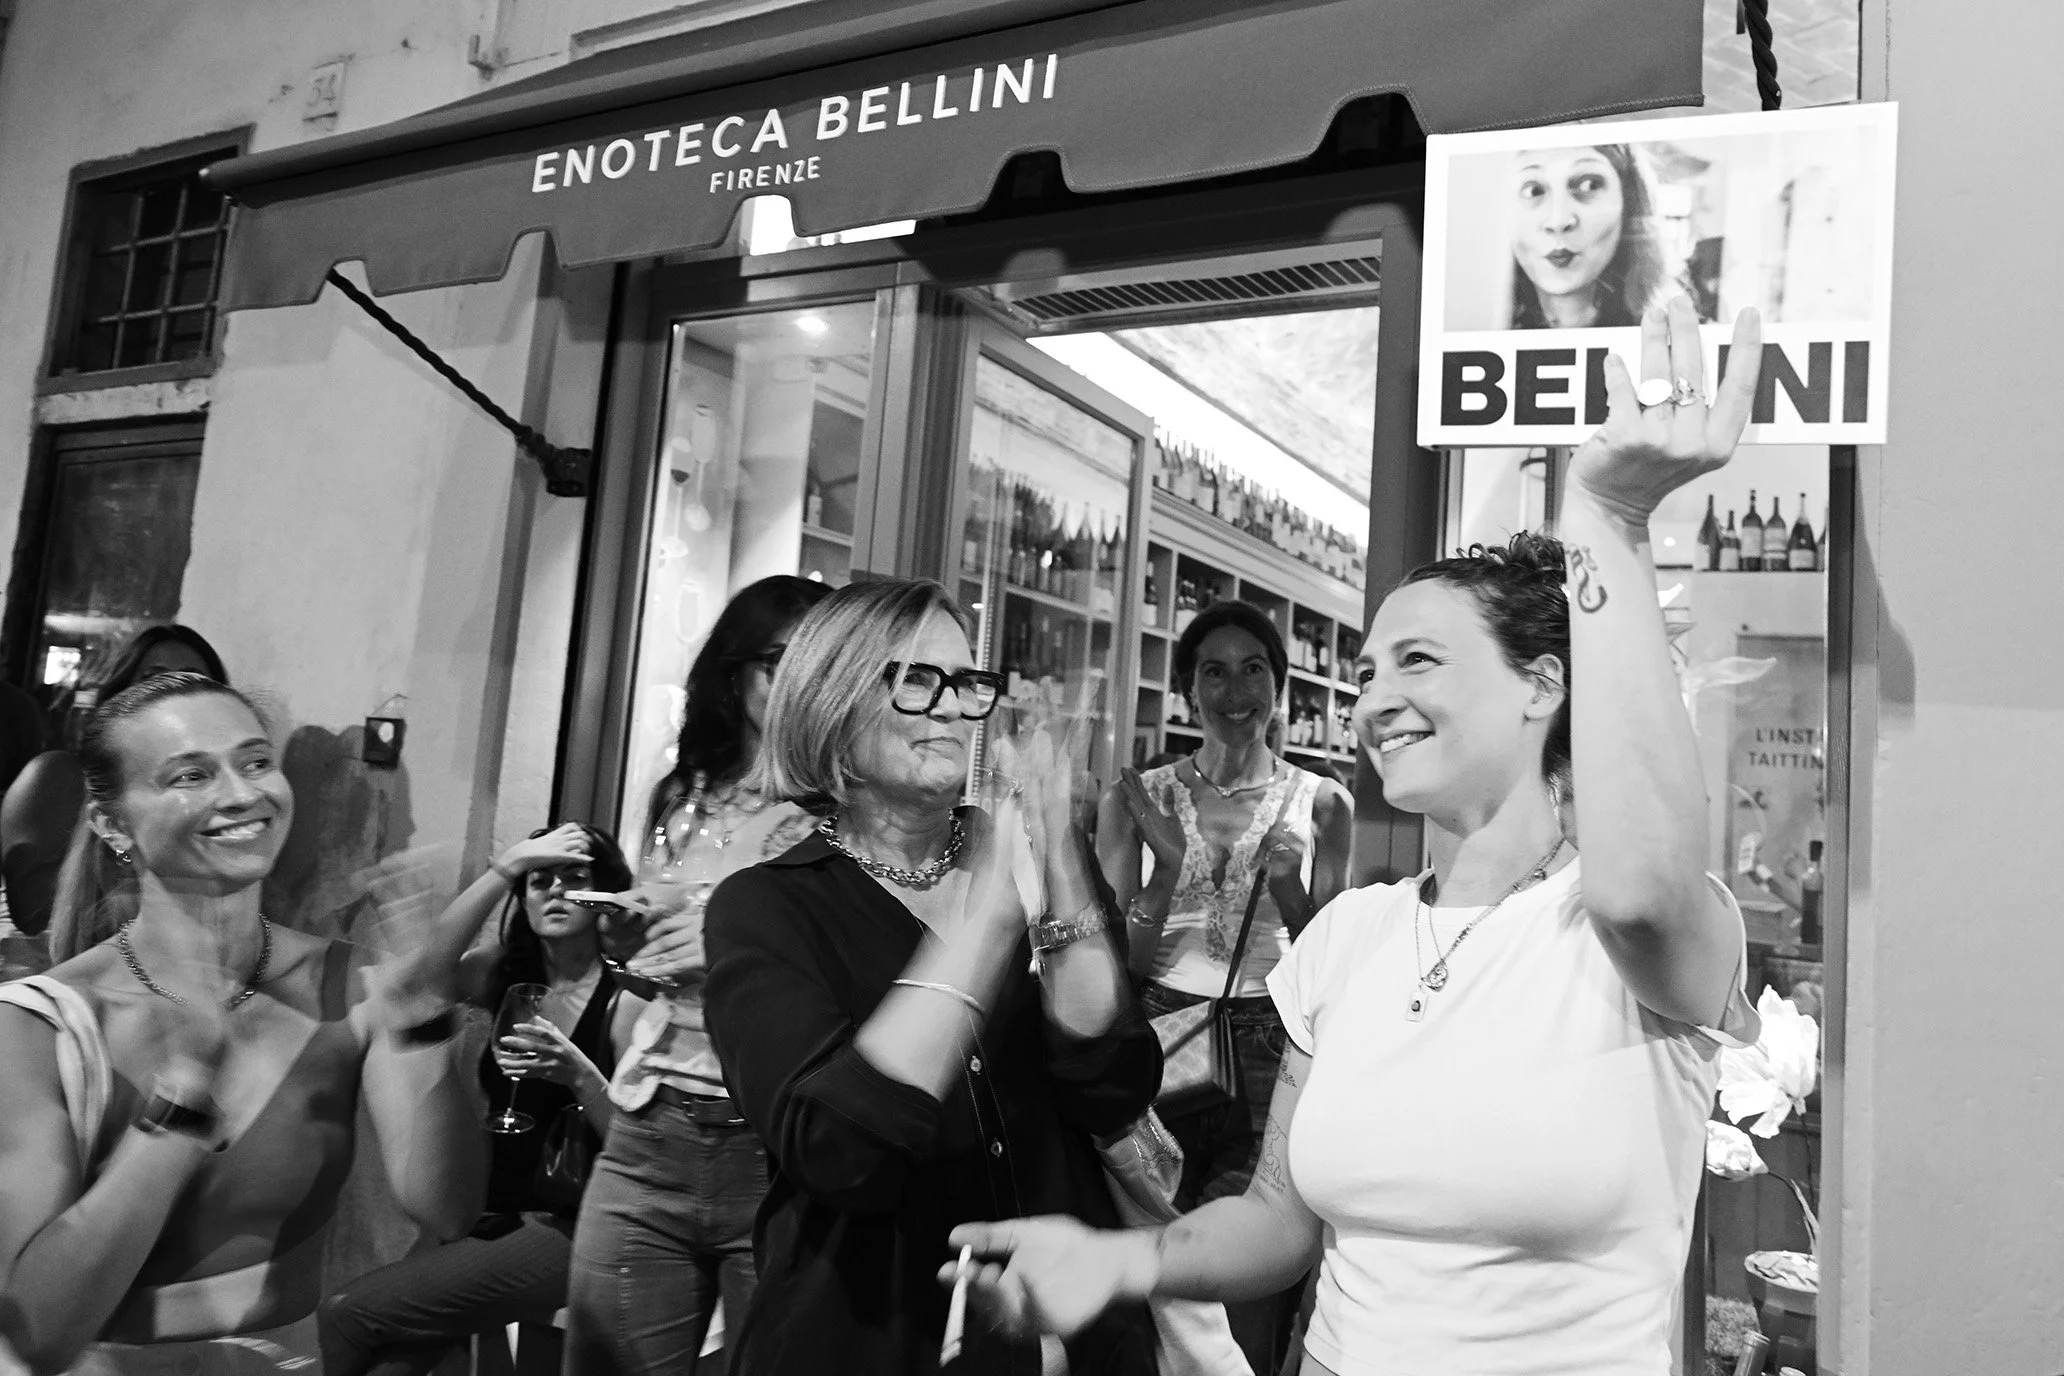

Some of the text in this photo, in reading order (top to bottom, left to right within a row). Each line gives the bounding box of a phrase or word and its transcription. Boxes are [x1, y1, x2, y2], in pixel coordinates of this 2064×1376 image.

[531, 53, 1058, 193] ENOTECA BELLINI
[709, 156, 821, 193] FIRENZE
[1756, 727, 1823, 744] L'INST
